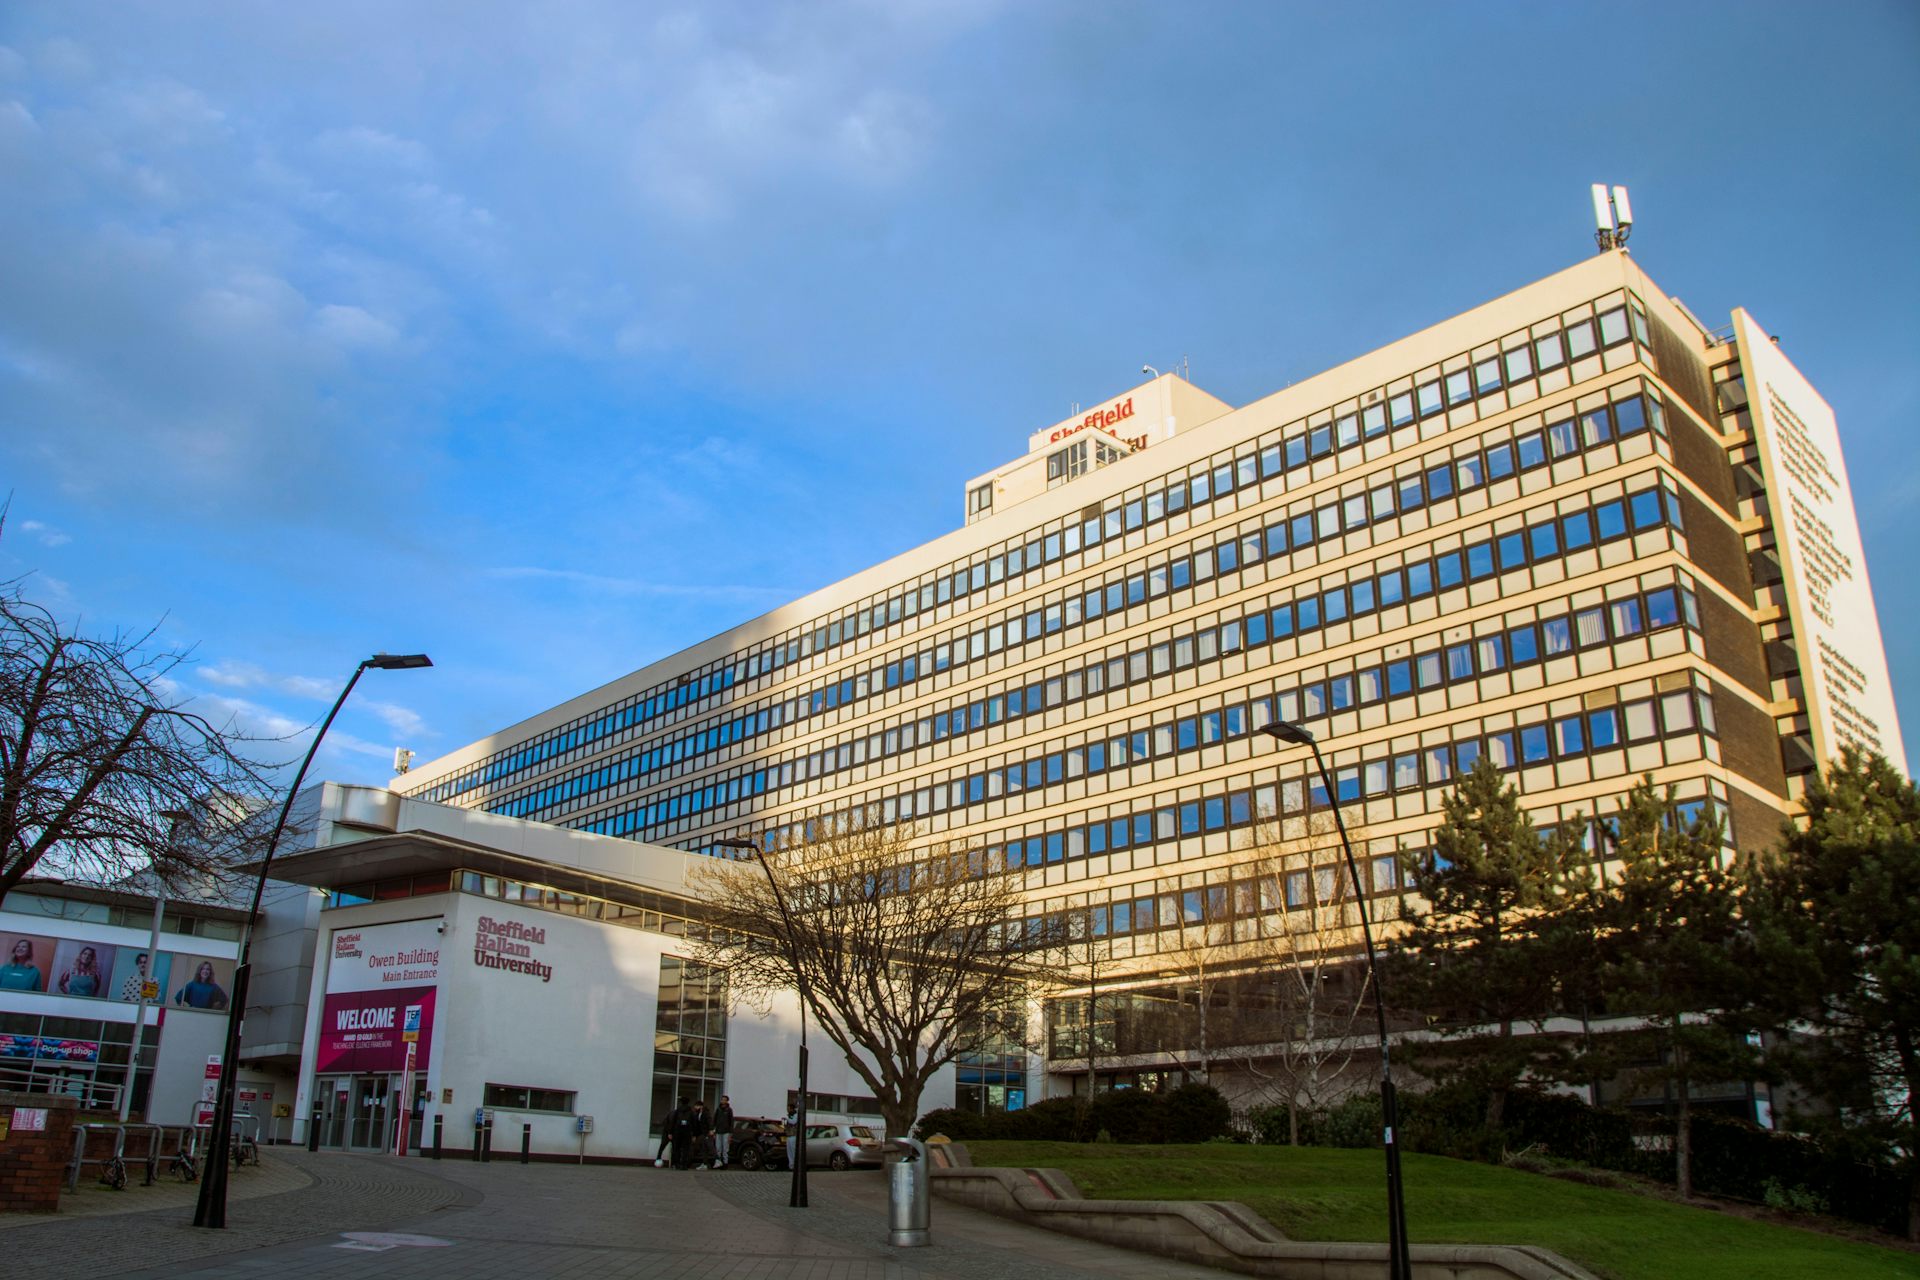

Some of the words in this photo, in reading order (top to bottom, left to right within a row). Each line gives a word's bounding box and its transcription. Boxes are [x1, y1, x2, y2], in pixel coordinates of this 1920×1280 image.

[477, 916, 546, 945] Sheffield
[475, 932, 531, 958] Hallam
[368, 953, 395, 969] Owen
[397, 949, 440, 968] Building
[474, 949, 553, 983] University
[382, 971, 402, 983] Main
[403, 968, 438, 981] Entrance
[337, 1007, 396, 1030] WELCOME
[73, 1047, 94, 1056] shop
